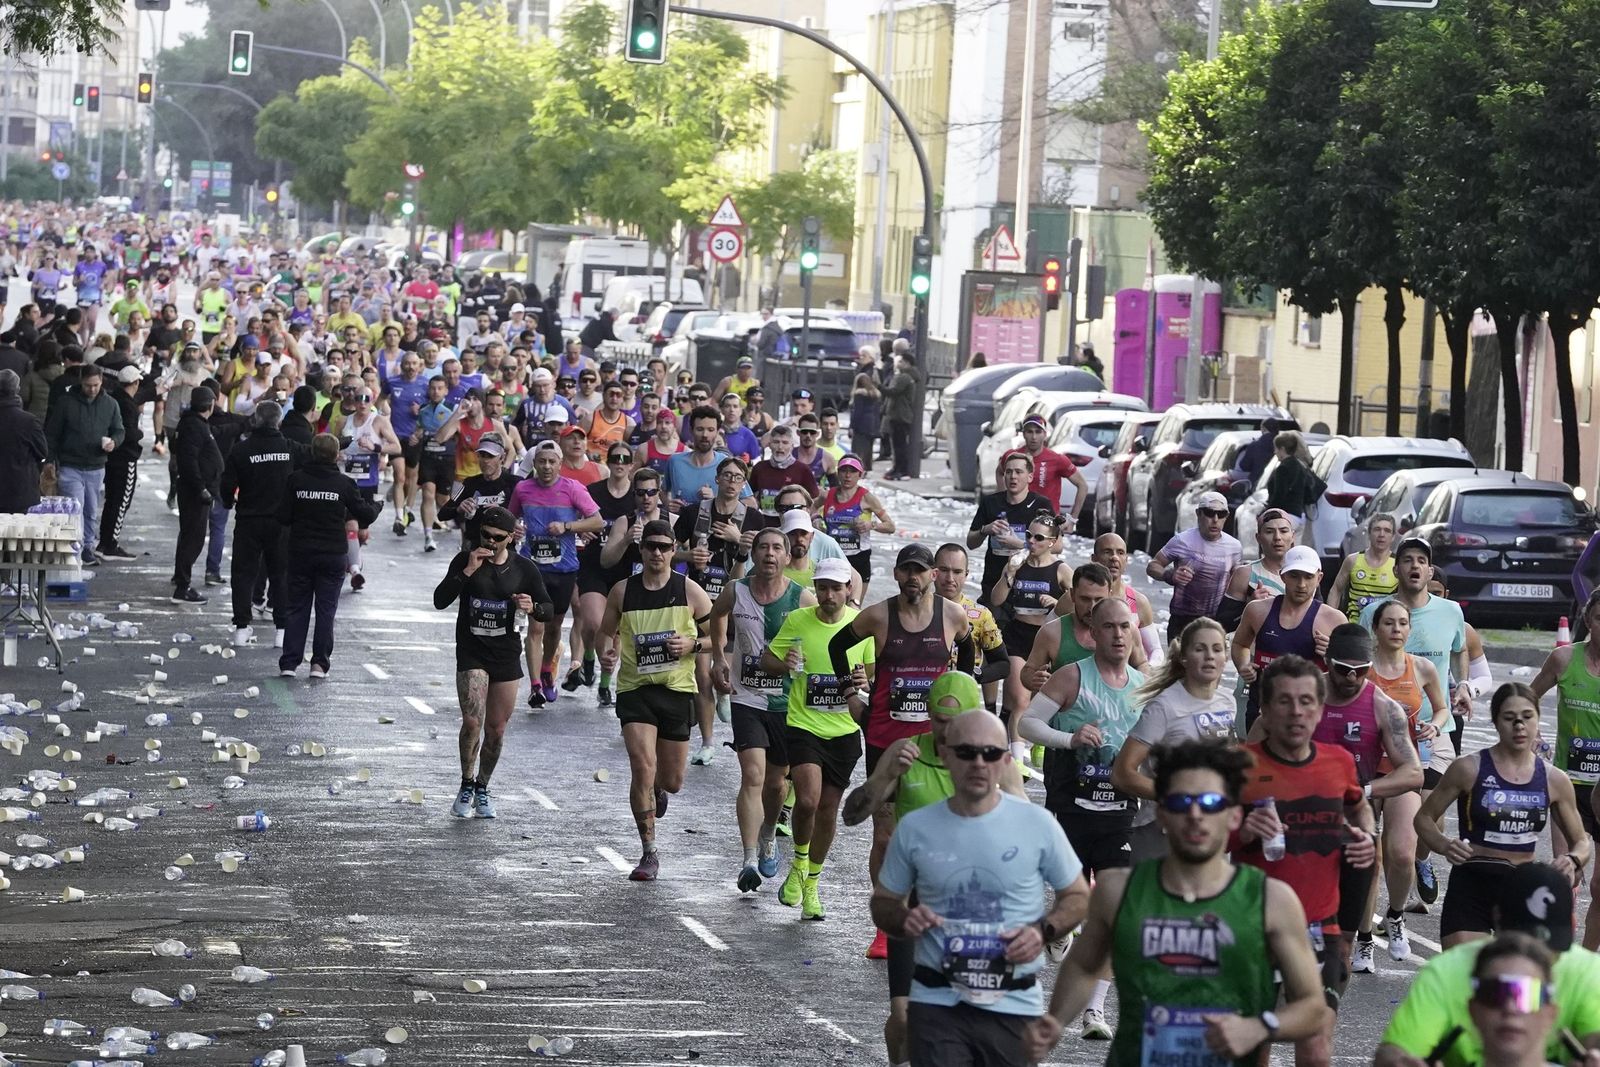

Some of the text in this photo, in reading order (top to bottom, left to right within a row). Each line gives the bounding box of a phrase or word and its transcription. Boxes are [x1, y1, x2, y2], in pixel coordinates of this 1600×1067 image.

[715, 239, 735, 251] 30
[250, 453, 290, 463] VOLUNTEER
[296, 490, 339, 501] VOLUNTEER
[705, 583, 724, 593] MATT
[1500, 585, 1550, 597] 4249 GBR
[478, 619, 498, 628] RAUL
[640, 653, 665, 666] DAVID
[741, 676, 783, 687] JOSÉ CRUZ
[813, 695, 847, 704] CARLOS
[900, 701, 927, 711] JORDI
[1092, 790, 1115, 801] IKER
[1510, 810, 1529, 819] 4197
[1143, 926, 1217, 961] GAMA
[967, 959, 990, 970] 5227
